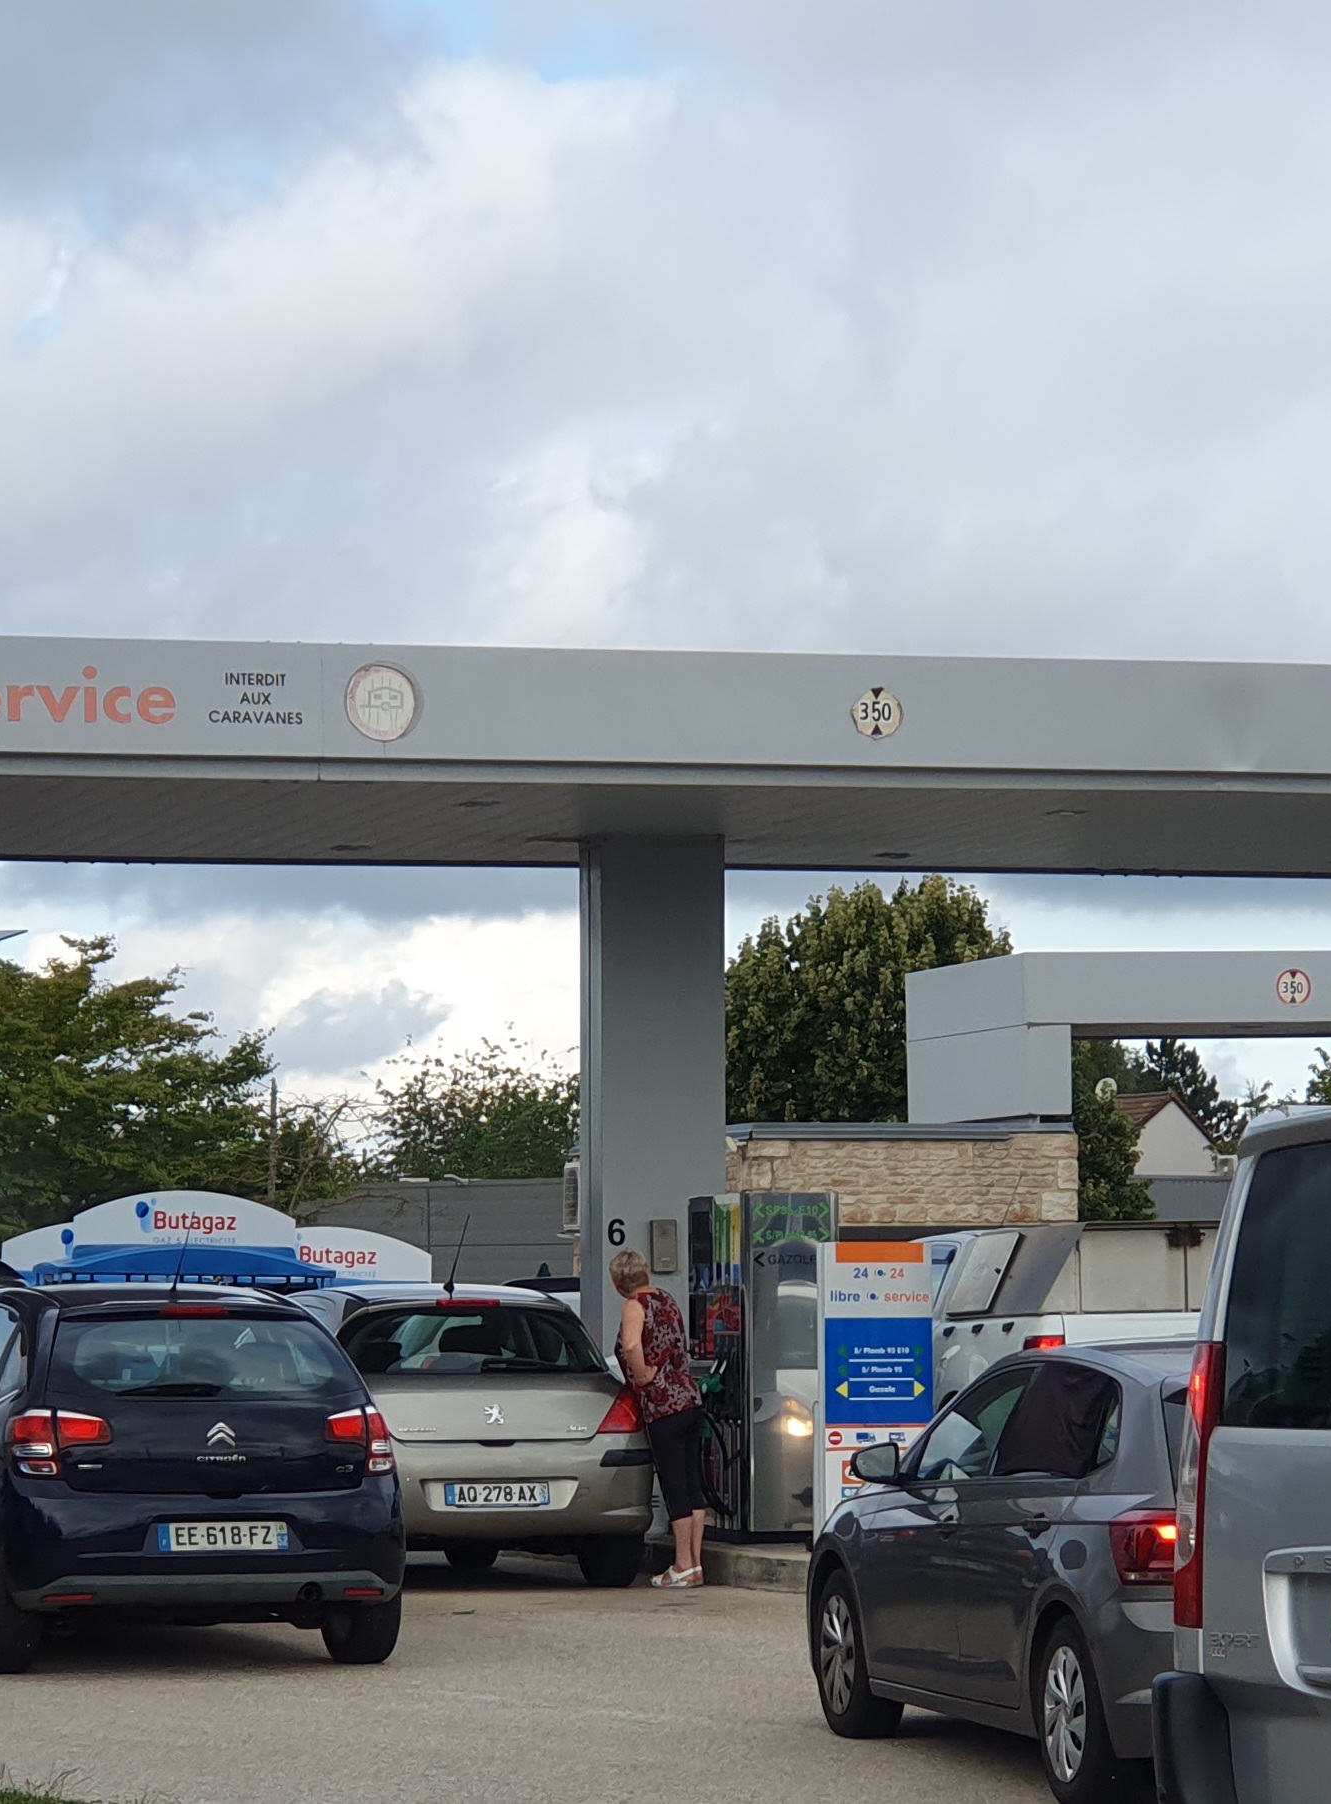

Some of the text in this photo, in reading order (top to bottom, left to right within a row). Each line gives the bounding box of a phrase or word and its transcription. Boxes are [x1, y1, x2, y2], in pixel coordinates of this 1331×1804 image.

[224, 672, 287, 687] INTERDIT
[239, 691, 272, 706] AUX
[208, 709, 304, 726] CARAVANES
[859, 700, 892, 722] 350
[1281, 980, 1304, 995] 350
[154, 1211, 237, 1234] Butagaz
[608, 1218, 626, 1246] 6
[299, 1246, 377, 1267] Butagaz
[853, 1267, 905, 1279] 24 24
[830, 1290, 930, 1303] libre service
[175, 1526, 273, 1546] EE-618-FZ
